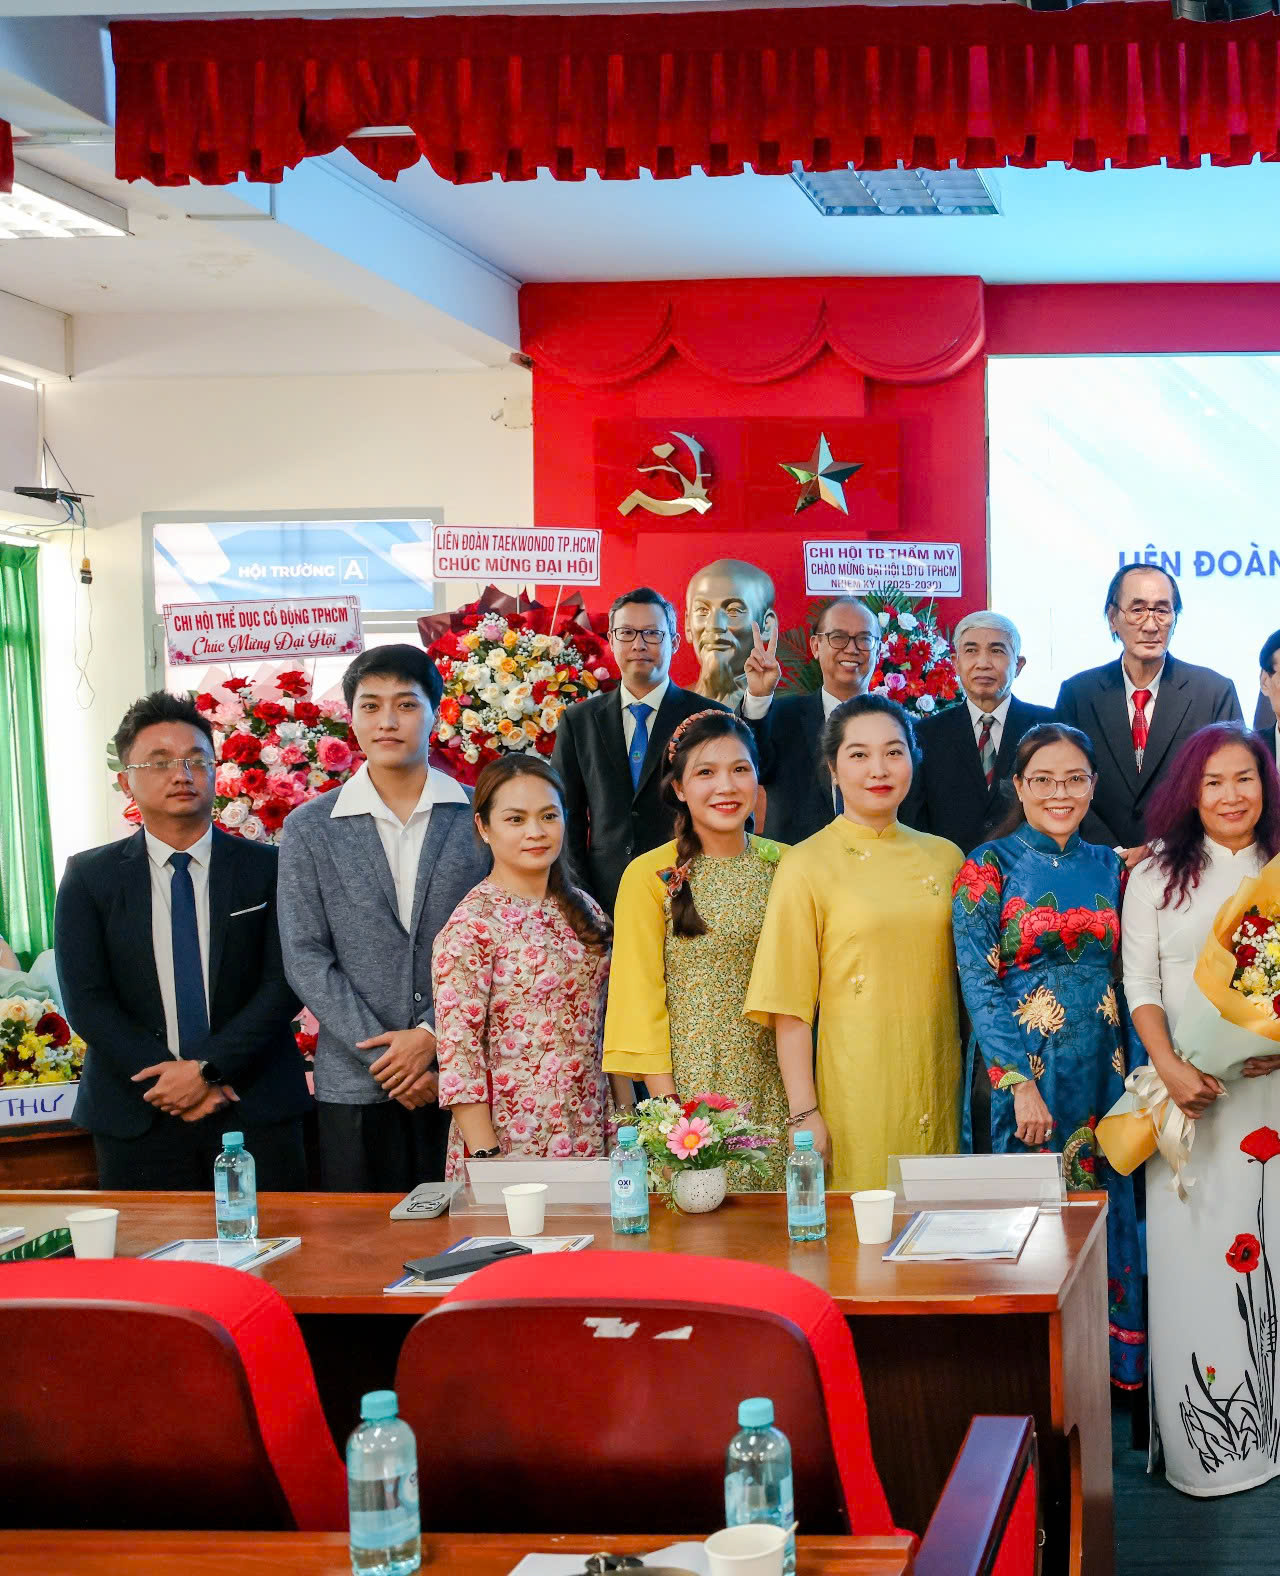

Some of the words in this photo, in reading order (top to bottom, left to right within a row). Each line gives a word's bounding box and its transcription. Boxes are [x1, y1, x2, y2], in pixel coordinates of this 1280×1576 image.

[437, 531, 459, 551] LIÊN
[462, 531, 489, 551] ĐOÀN
[492, 534, 555, 553] TAEKWONDO
[557, 536, 596, 553] TP.HCM
[810, 547, 833, 558] CHI
[838, 546, 862, 560] HỘI
[888, 545, 929, 560] THẨM
[933, 548, 955, 561] MỸ
[238, 563, 267, 580] HỘI
[271, 563, 337, 578] TRƯỜNG
[343, 559, 364, 580] A
[439, 555, 481, 571] CHÚC
[485, 556, 531, 573] MỪNG
[536, 559, 562, 575] ĐẠI
[567, 558, 593, 576] HỘI
[811, 561, 836, 575] CHÀO
[838, 561, 865, 576] MỪNG
[884, 563, 900, 578] HỘI
[927, 565, 957, 577] TPHCM
[174, 614, 192, 632] CHI
[195, 611, 214, 634] HỘI
[216, 605, 236, 629] THỂ
[239, 610, 261, 631] DỤC
[311, 607, 349, 624] TPHCM
[192, 636, 225, 656] Chúc
[228, 633, 270, 654] Mừng
[273, 631, 305, 651] Đại
[308, 629, 337, 649] Hội
[0, 1093, 64, 1117] THƯ
